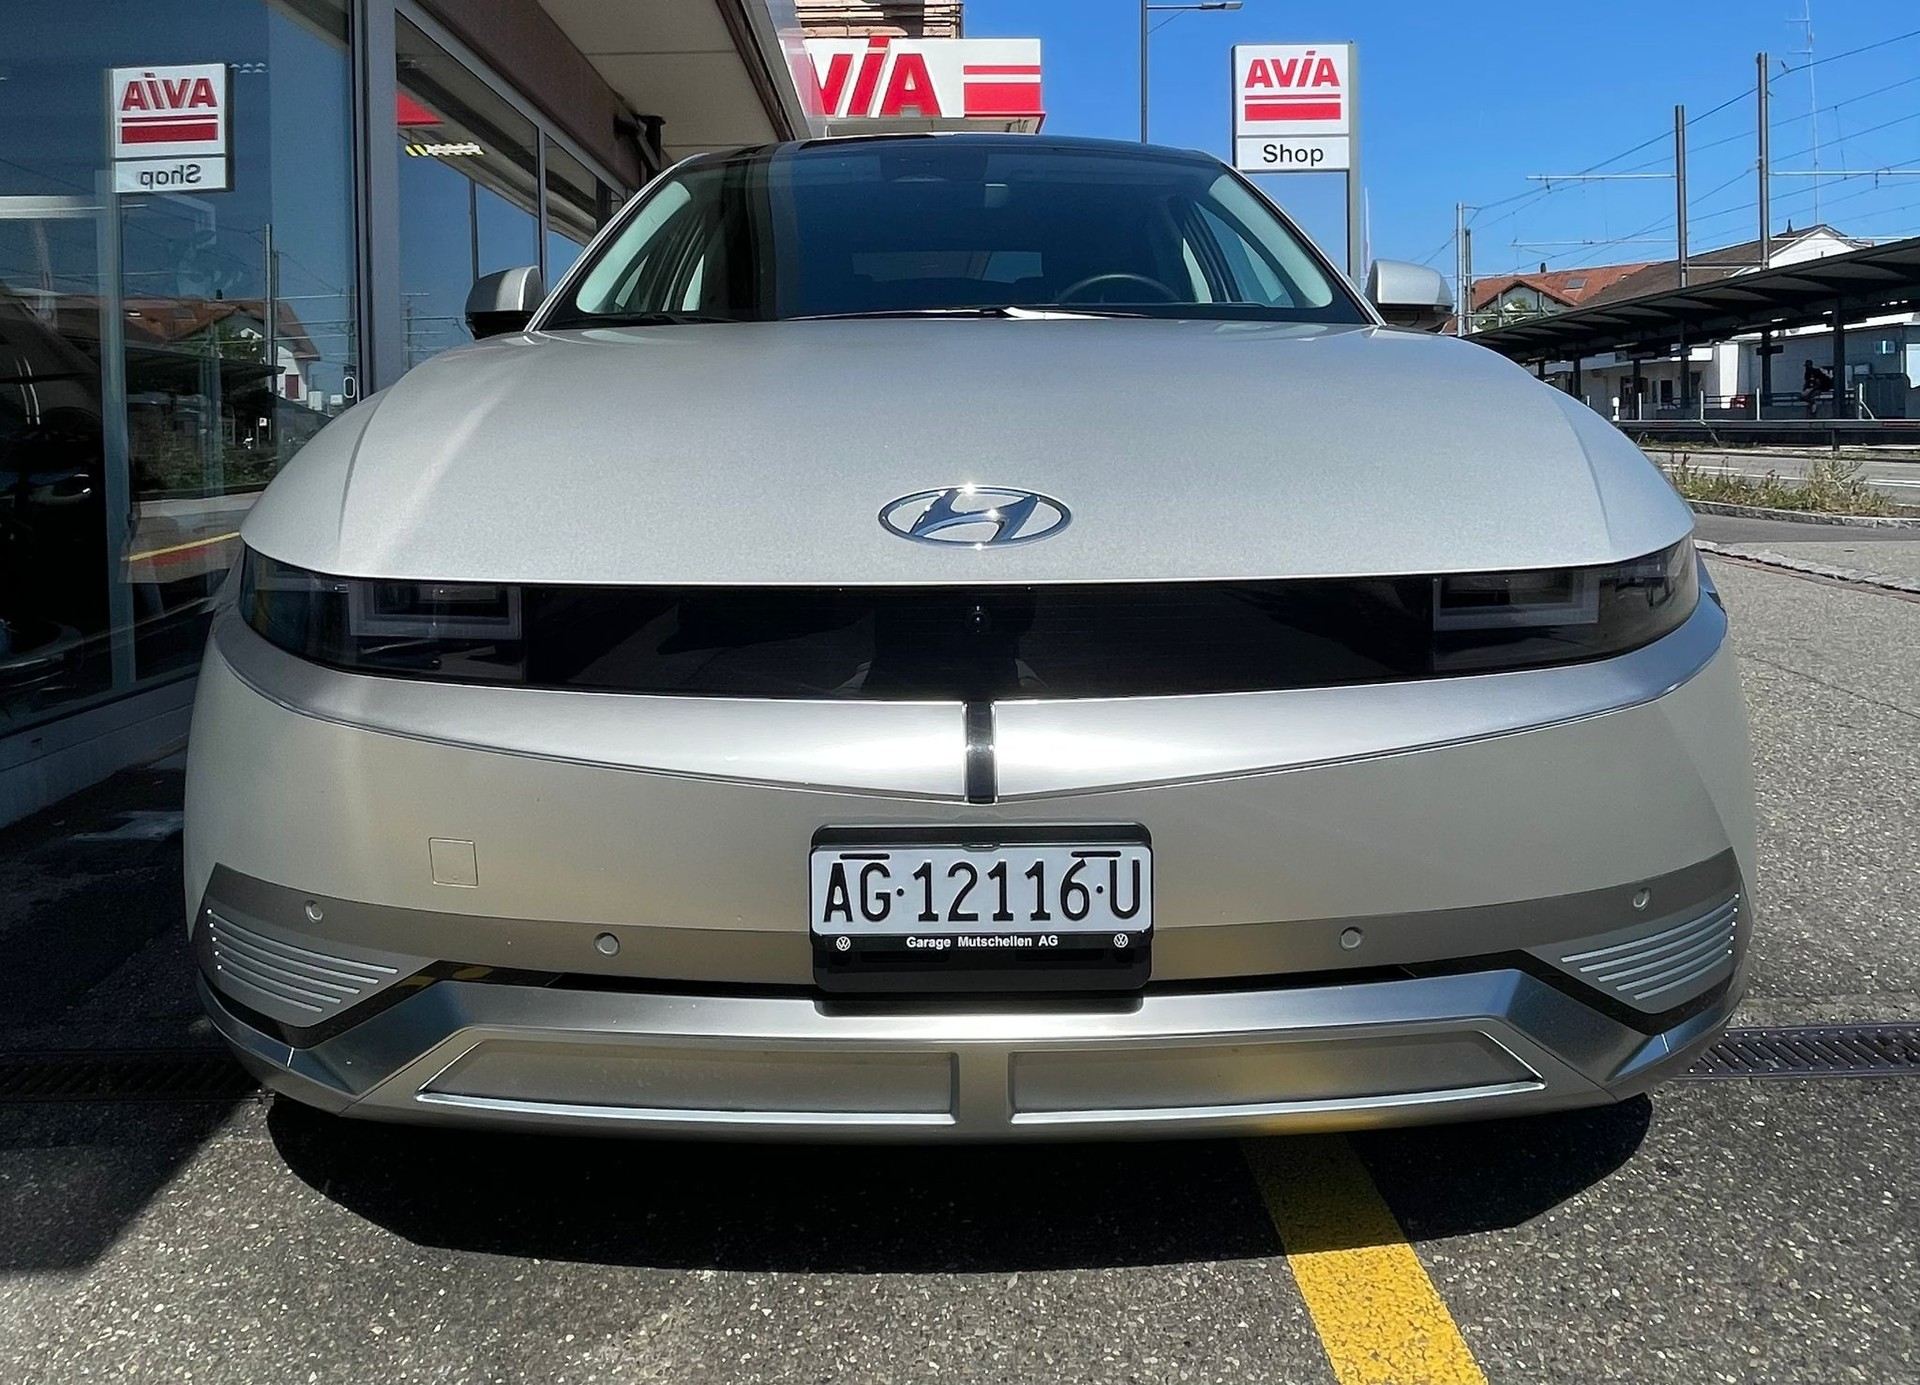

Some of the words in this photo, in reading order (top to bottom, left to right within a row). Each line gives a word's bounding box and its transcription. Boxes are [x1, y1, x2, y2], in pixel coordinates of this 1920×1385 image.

[809, 36, 942, 116] VIA
[1244, 50, 1341, 88] AVIA
[1262, 143, 1324, 167] Shop
[906, 936, 951, 950] Garage
[957, 935, 1032, 947] Mutschellen
[1038, 935, 1059, 947] AG
